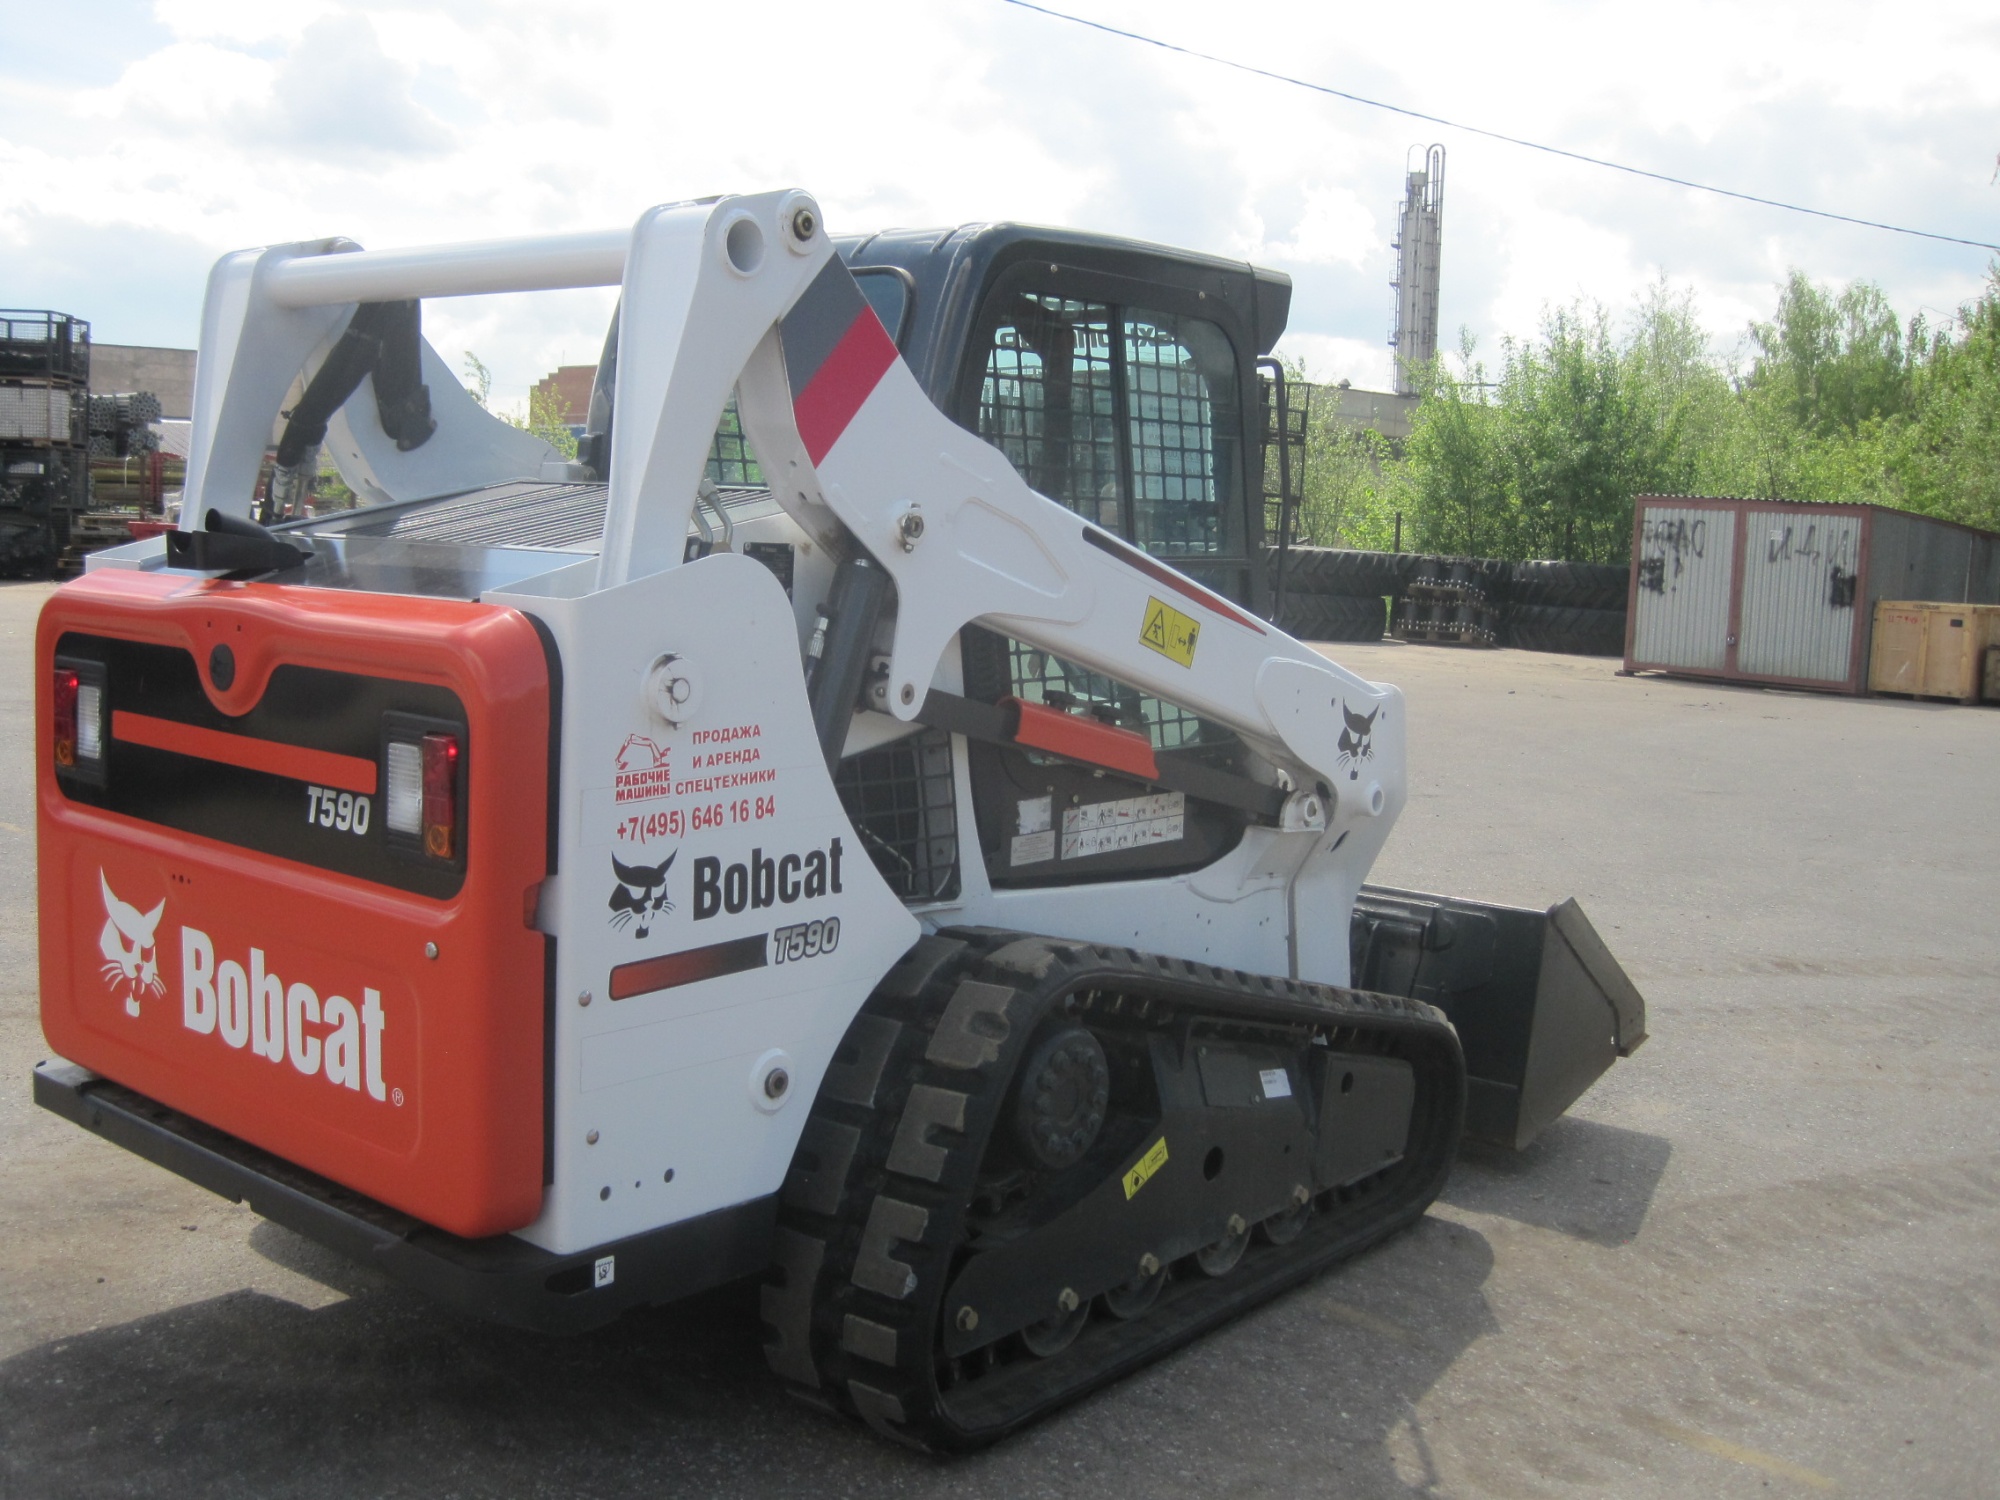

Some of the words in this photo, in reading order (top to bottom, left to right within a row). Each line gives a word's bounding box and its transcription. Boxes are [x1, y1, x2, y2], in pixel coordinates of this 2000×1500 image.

[692, 724, 761, 745] ПРОДАЖА
[692, 755, 702, 769] И
[706, 748, 761, 767] АРЕНДА
[615, 769, 671, 788] РАБОЧИЕ
[615, 783, 671, 801] МАШИНЫ
[675, 768, 776, 796] СПЕЦТЕХНИКИ
[308, 785, 371, 835] T590
[616, 809, 686, 845] +7(495)
[691, 803, 724, 830] 646
[730, 799, 750, 823] 16
[755, 795, 775, 820] 84
[692, 837, 843, 921] Bobcat
[773, 916, 841, 965] T590
[180, 925, 387, 1103] Bobcat
